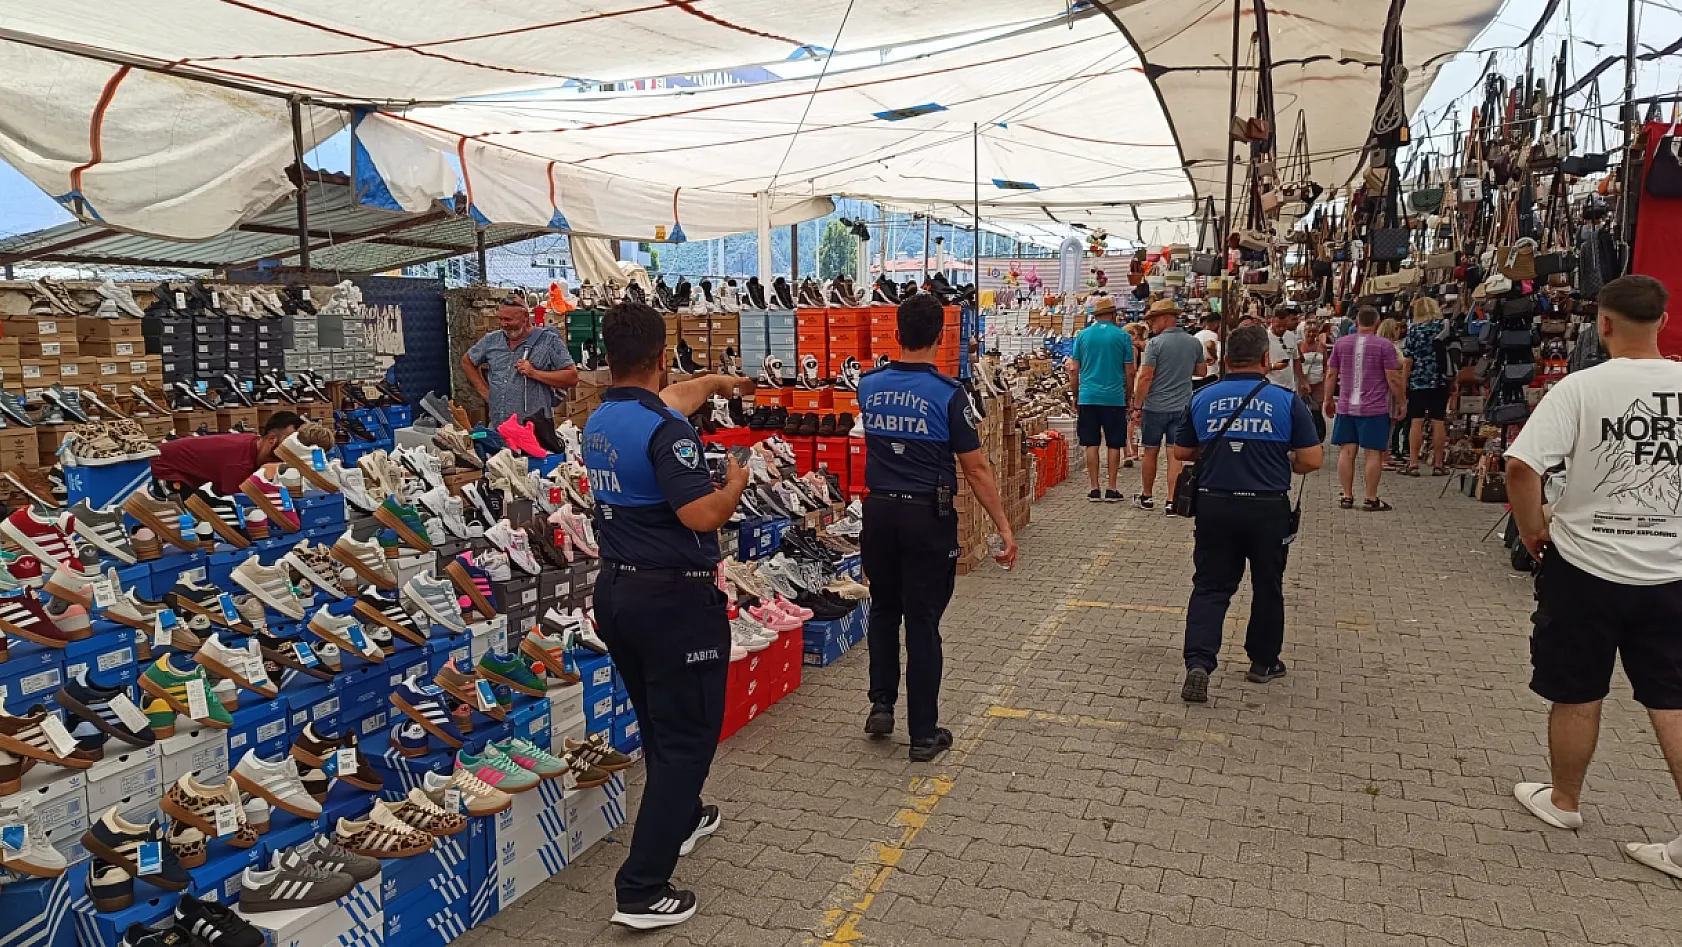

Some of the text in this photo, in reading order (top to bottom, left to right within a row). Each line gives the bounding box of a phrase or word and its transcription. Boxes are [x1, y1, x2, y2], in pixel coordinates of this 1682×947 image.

[866, 390, 929, 416] FETHİYE
[1652, 392, 1682, 415] T
[865, 412, 929, 435] ZABITA
[1635, 441, 1682, 466] FA
[587, 468, 622, 494] BITA
[686, 649, 719, 664] ZABITA
